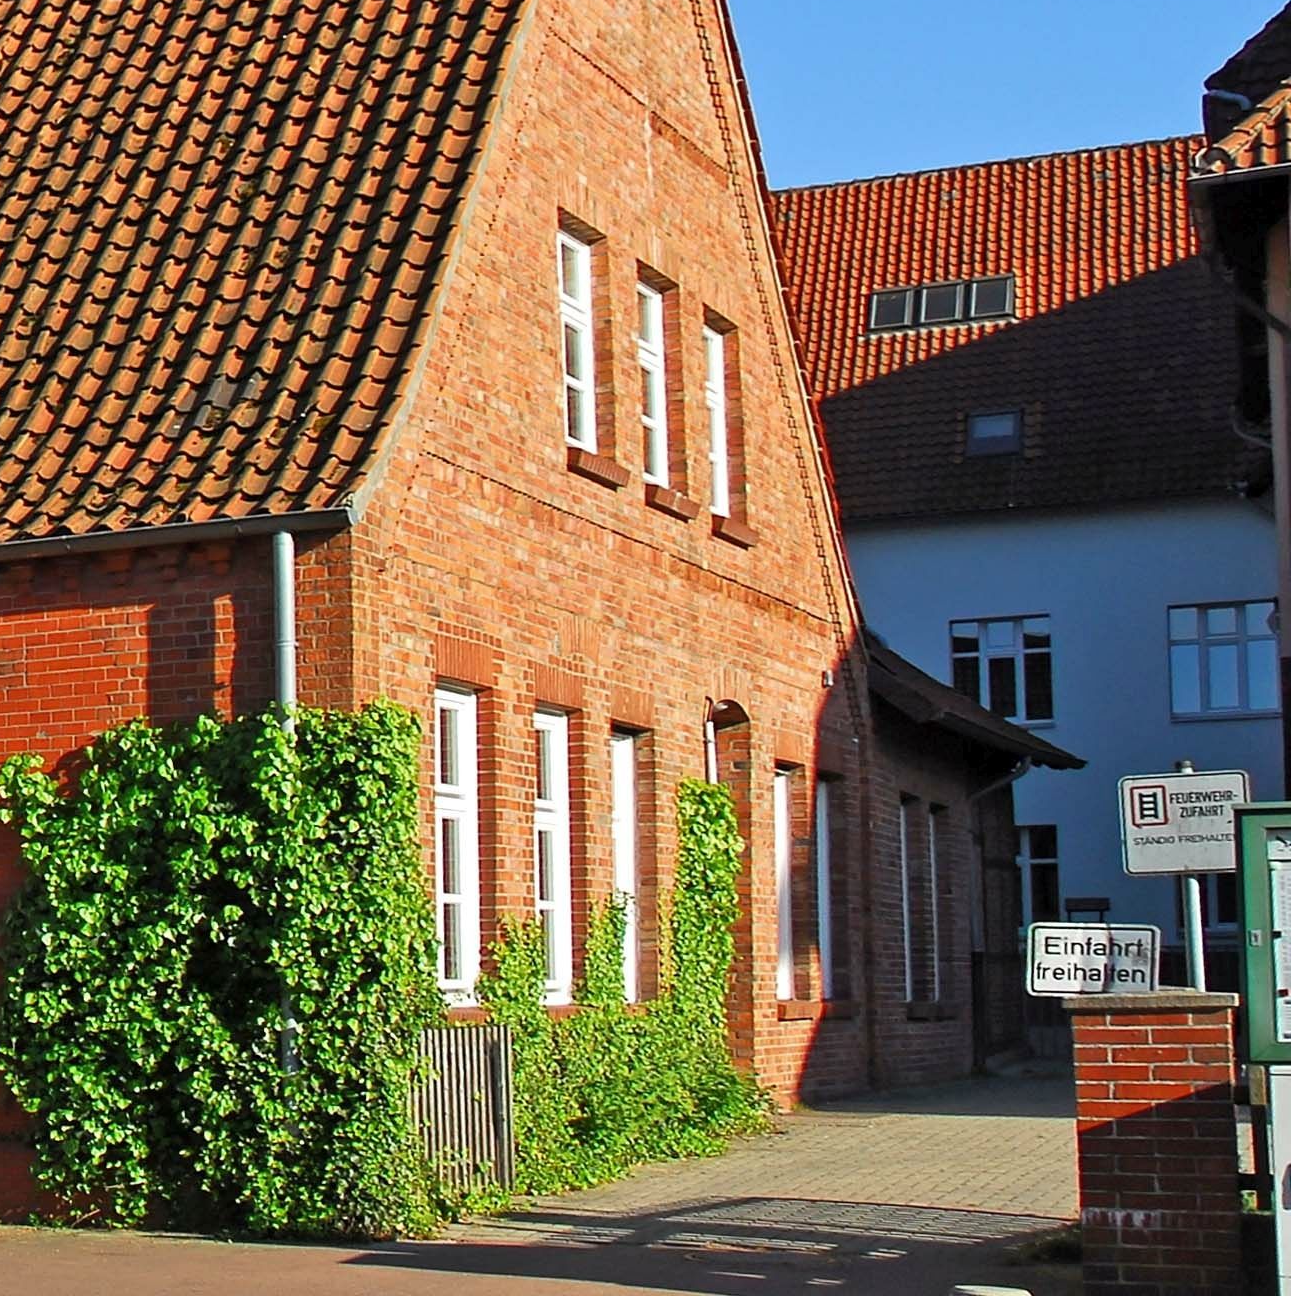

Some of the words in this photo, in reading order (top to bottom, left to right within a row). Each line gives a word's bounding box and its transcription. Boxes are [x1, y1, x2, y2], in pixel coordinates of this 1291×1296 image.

[1169, 790, 1238, 804] FEUERWEHR-
[1179, 805, 1224, 818] ZUFAHRT
[1178, 833, 1234, 843] FREIHALTE
[1044, 936, 1144, 957] Einfahrt
[1036, 962, 1146, 983] freihalten
